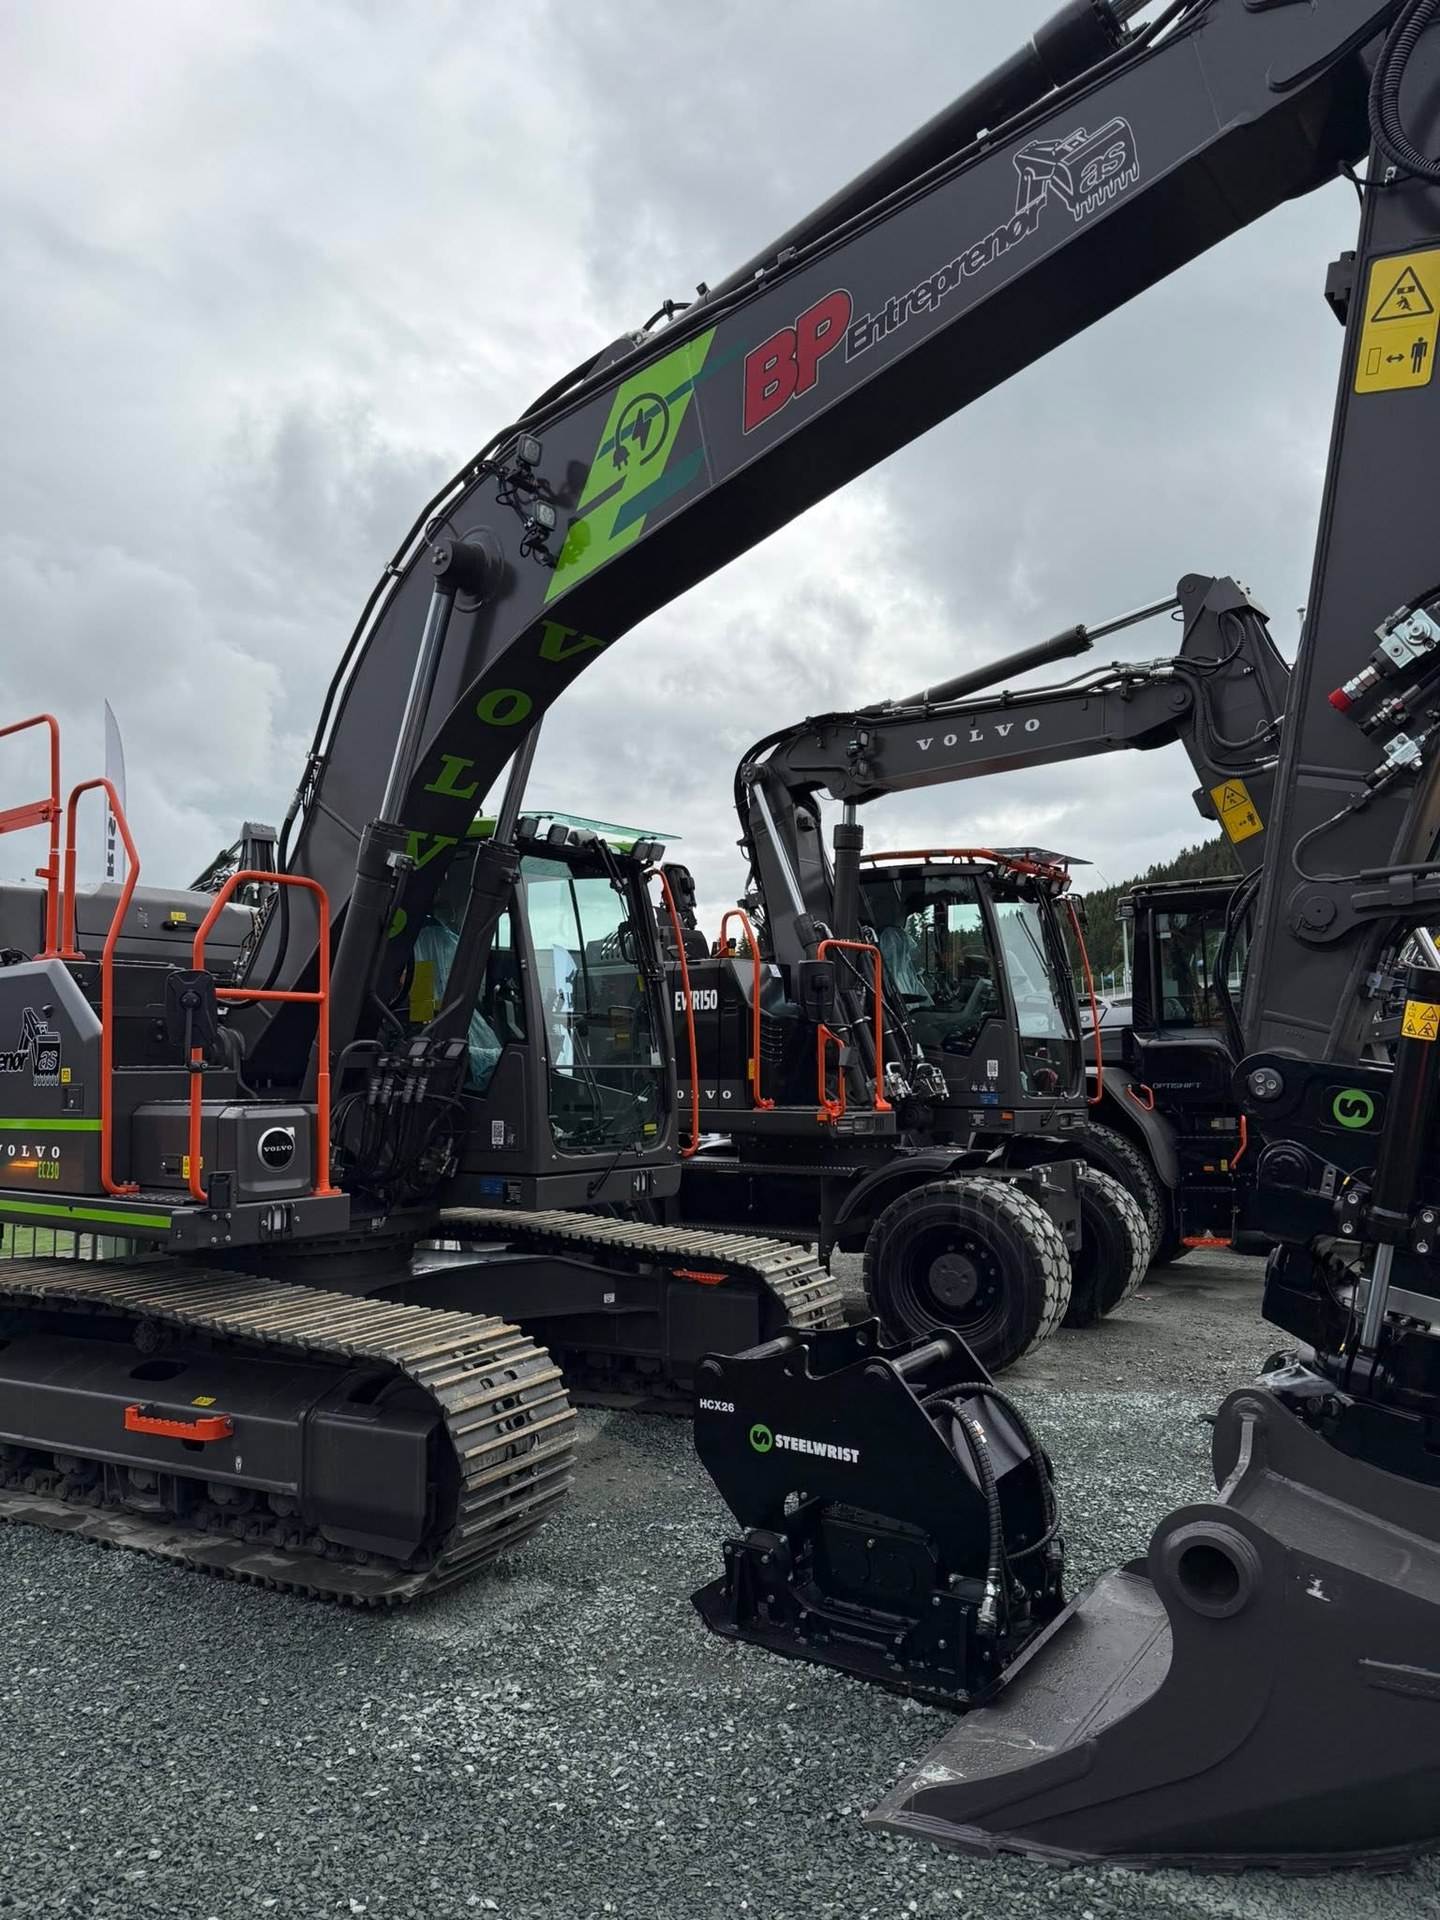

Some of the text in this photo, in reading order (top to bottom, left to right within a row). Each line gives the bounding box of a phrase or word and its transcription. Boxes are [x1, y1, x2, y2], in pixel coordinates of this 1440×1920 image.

[743, 288, 853, 436] BP
[1080, 141, 1125, 194] as
[916, 719, 1040, 750] VOLVO
[38, 1050, 59, 1071] as
[676, 1090, 732, 1100] OVO
[0, 1144, 61, 1159] OLVO
[263, 1145, 293, 1153] VOLVO
[38, 1161, 60, 1179] EC230
[700, 1398, 735, 1413] HCX26
[775, 1433, 860, 1464] STEELWRIST
